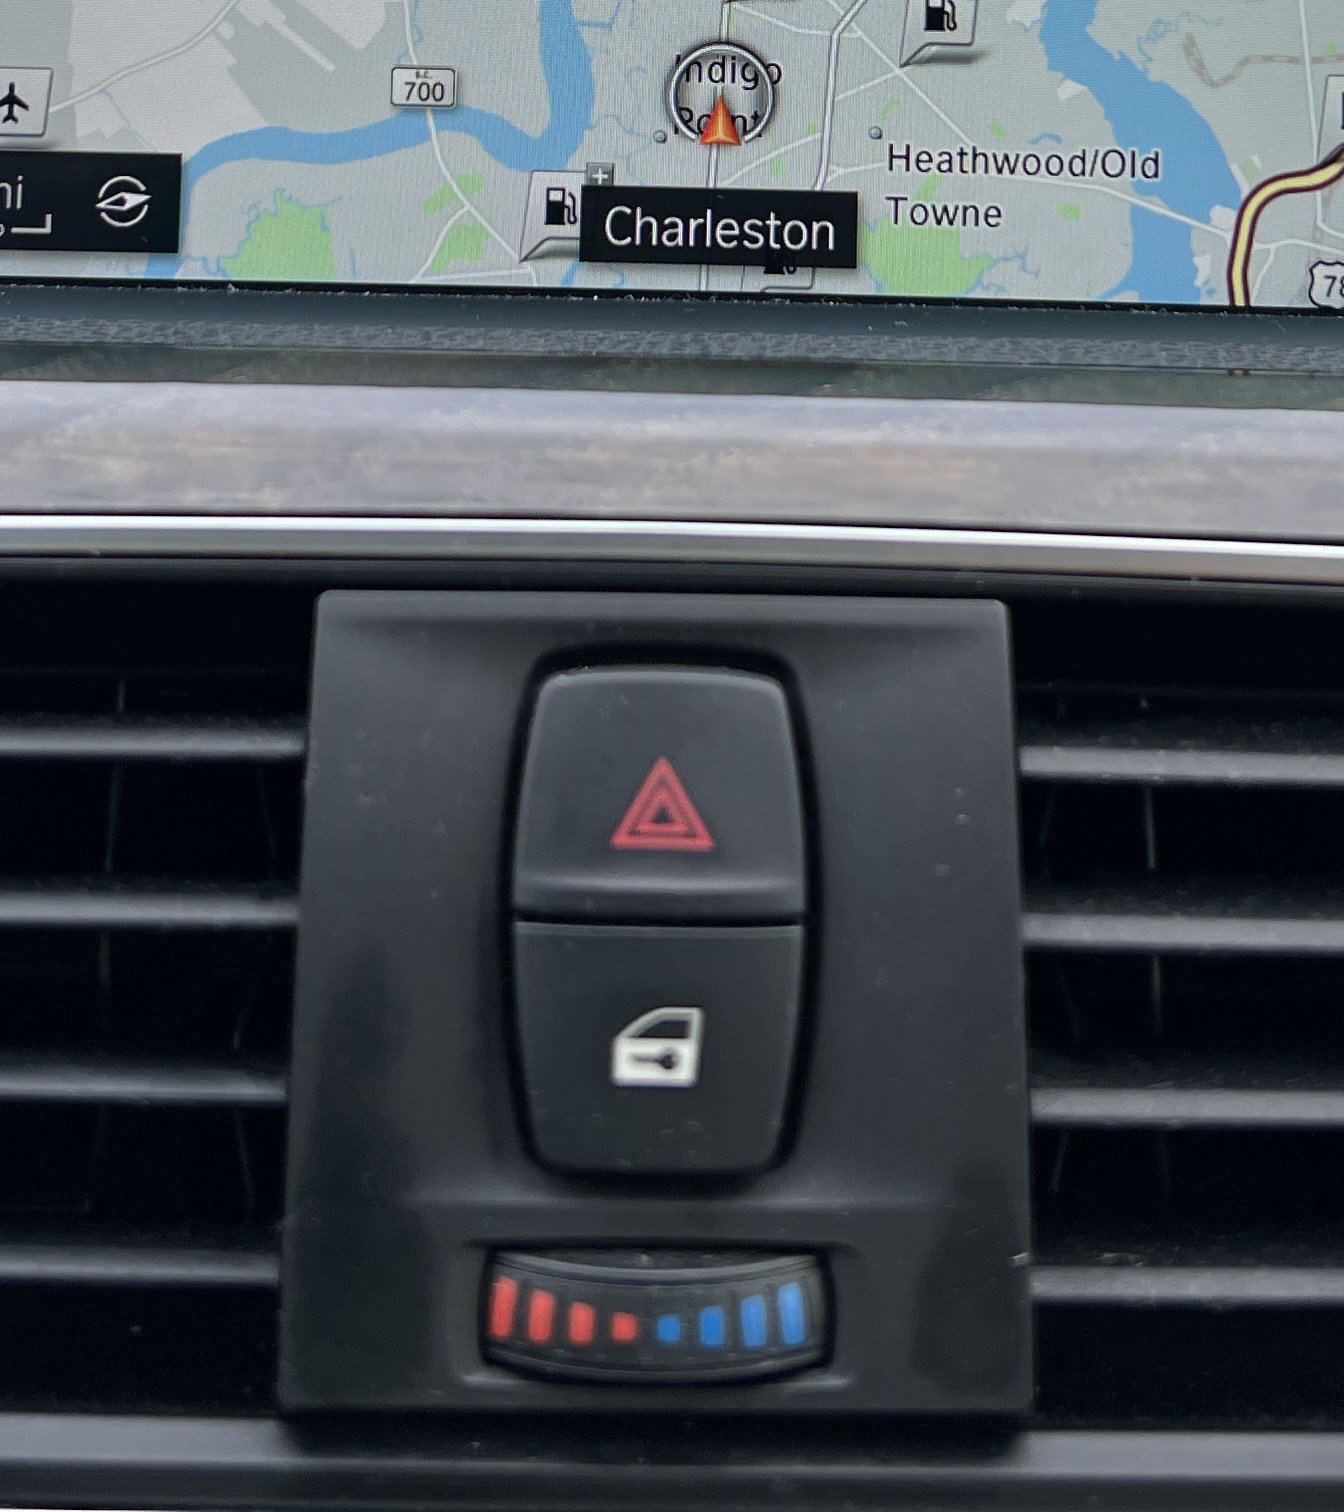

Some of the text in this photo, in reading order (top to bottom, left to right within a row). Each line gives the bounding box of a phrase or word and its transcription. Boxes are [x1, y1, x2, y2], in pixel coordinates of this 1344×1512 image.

[404, 81, 444, 102] 700
[887, 143, 1161, 181] Heathwood/Old
[604, 205, 836, 252] Charleston
[886, 197, 1003, 228] Towne
